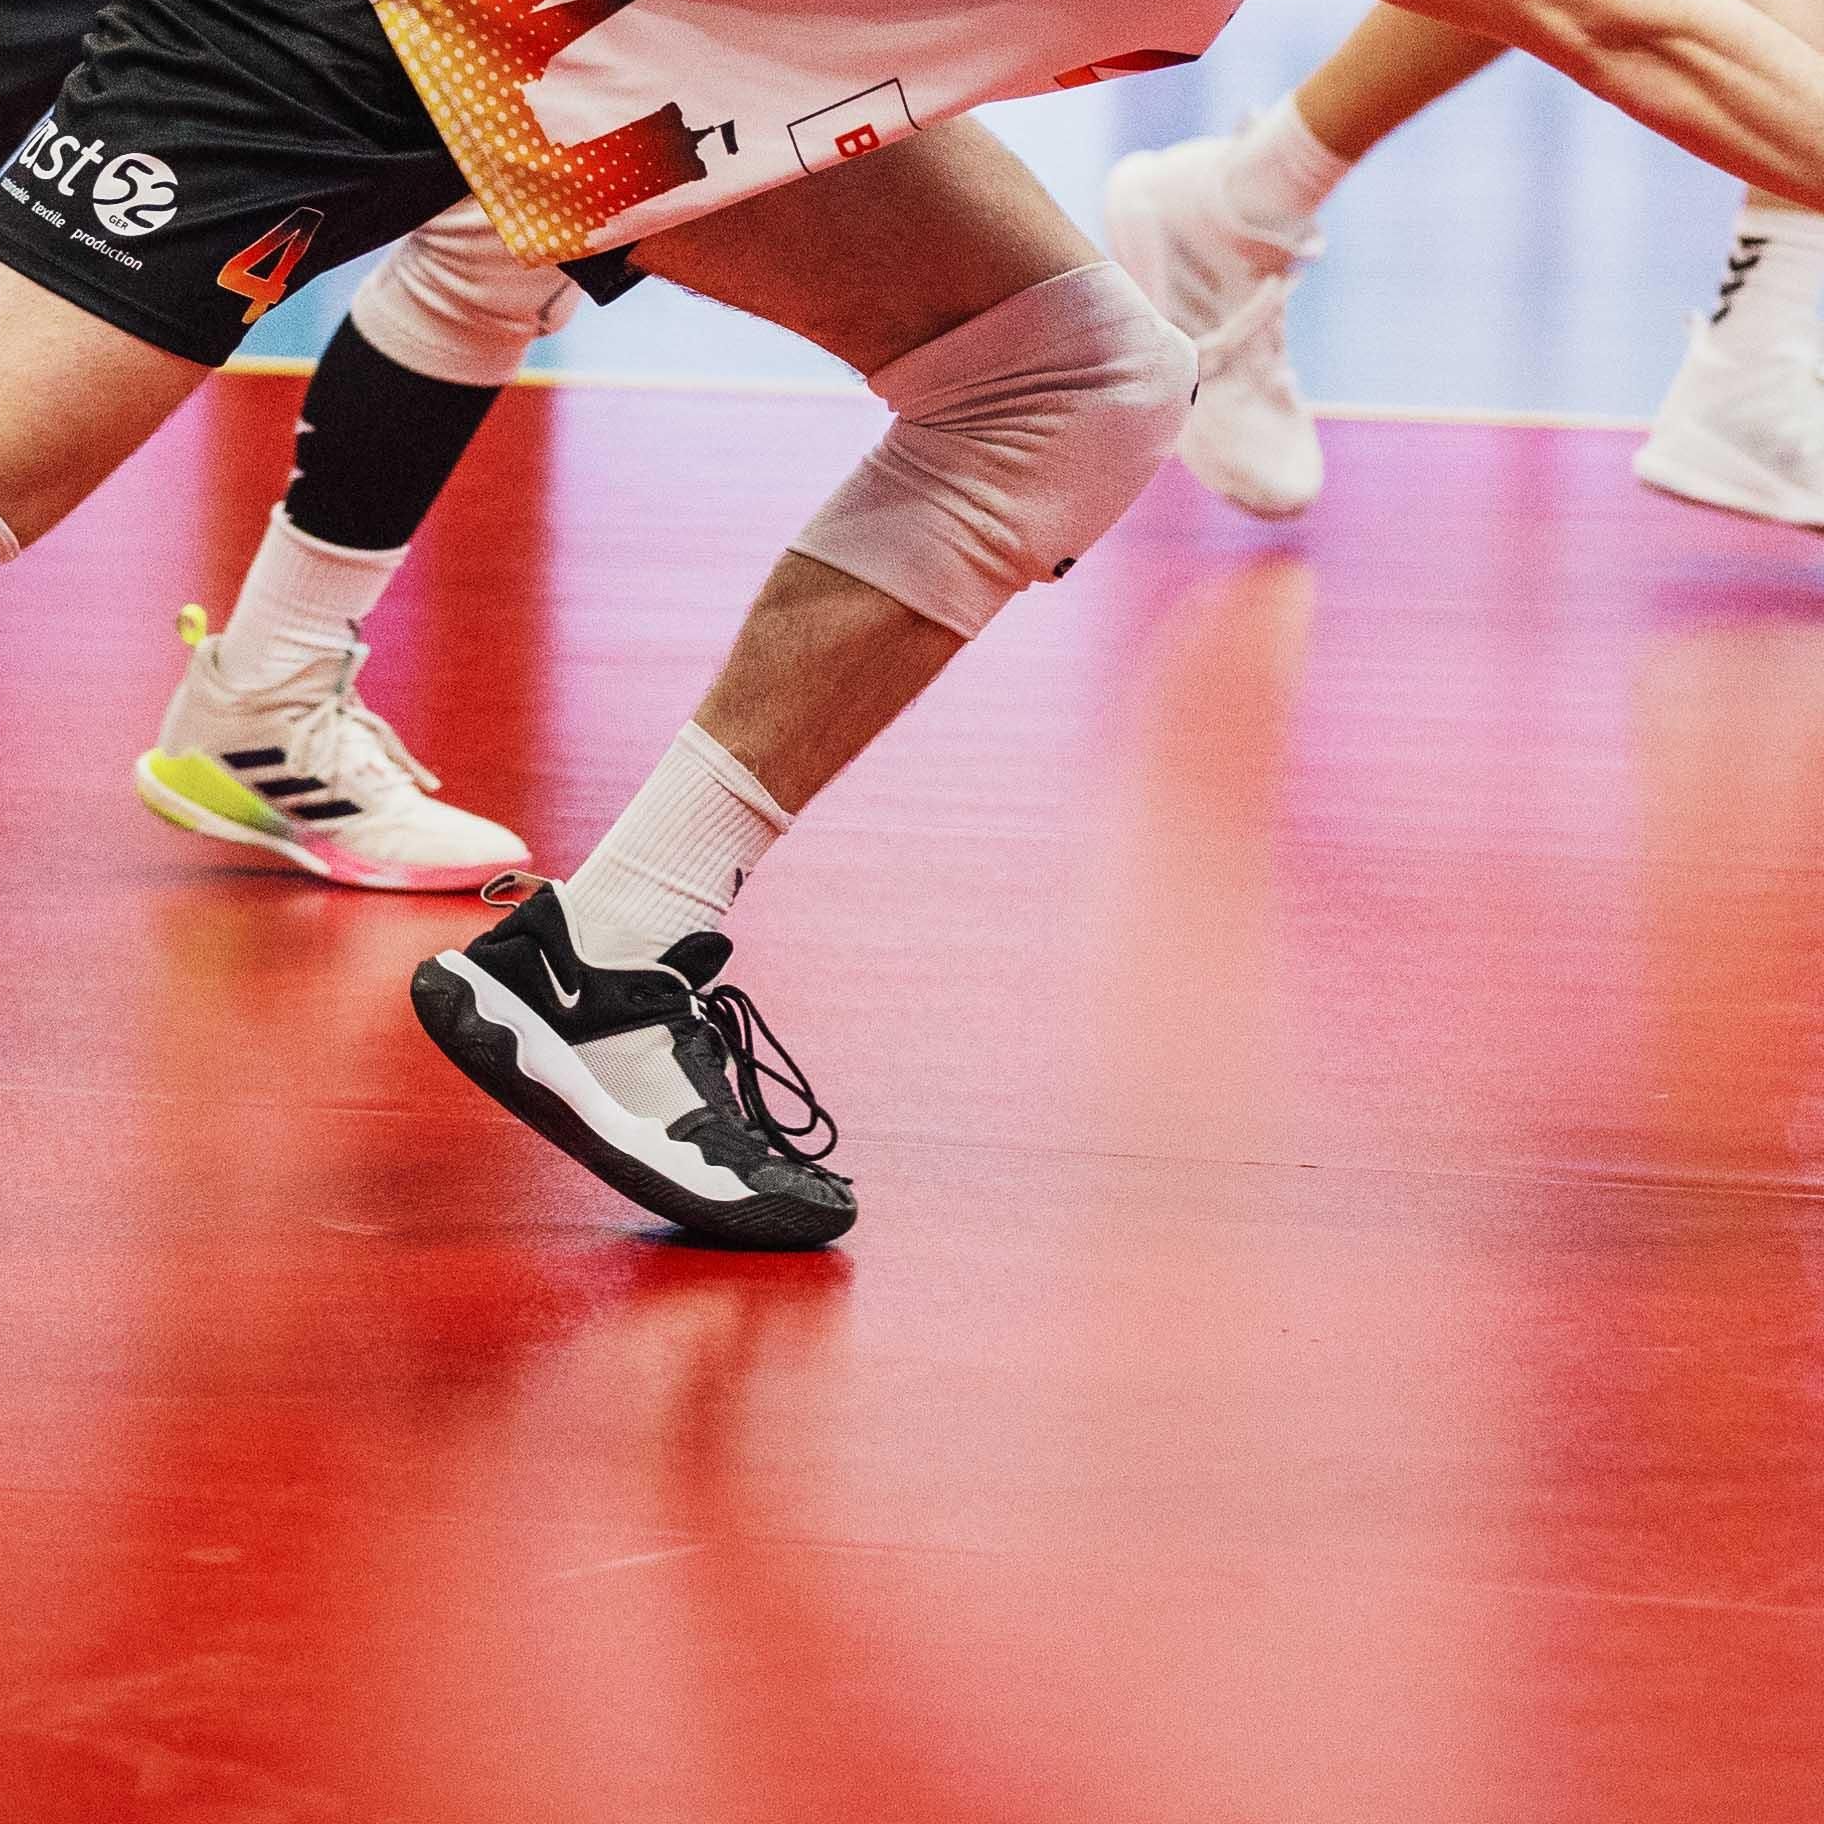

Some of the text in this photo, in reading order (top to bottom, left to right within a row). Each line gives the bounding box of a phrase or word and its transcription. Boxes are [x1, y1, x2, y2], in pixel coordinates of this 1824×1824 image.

[18, 118, 180, 231] ast 52
[835, 123, 882, 159] B
[31, 200, 66, 229] textile
[70, 229, 144, 272] production
[108, 214, 129, 231] GER
[217, 206, 325, 325] 4
